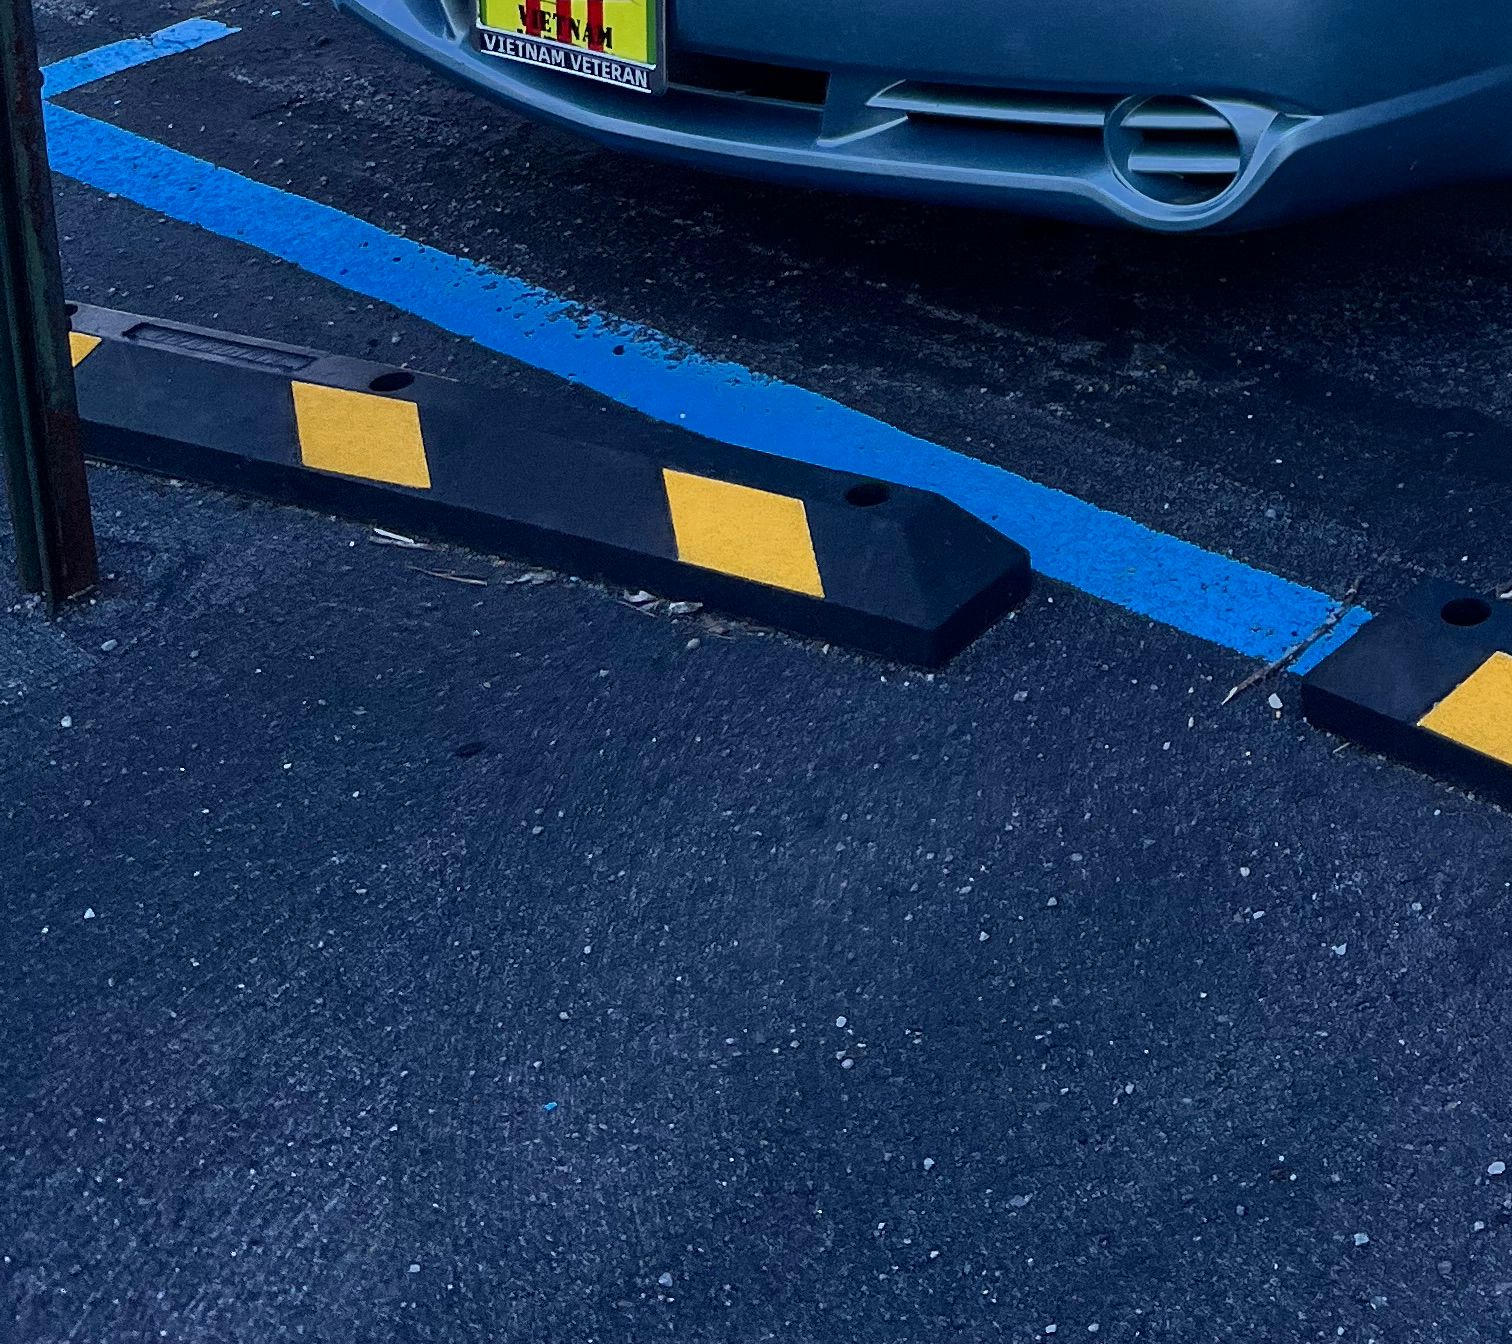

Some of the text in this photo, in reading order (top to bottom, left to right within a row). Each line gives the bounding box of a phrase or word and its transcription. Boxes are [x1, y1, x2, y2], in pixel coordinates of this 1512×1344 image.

[518, 4, 612, 49] VIETNAM
[484, 33, 566, 67] VIETNAM
[570, 53, 648, 88] VETERAN
